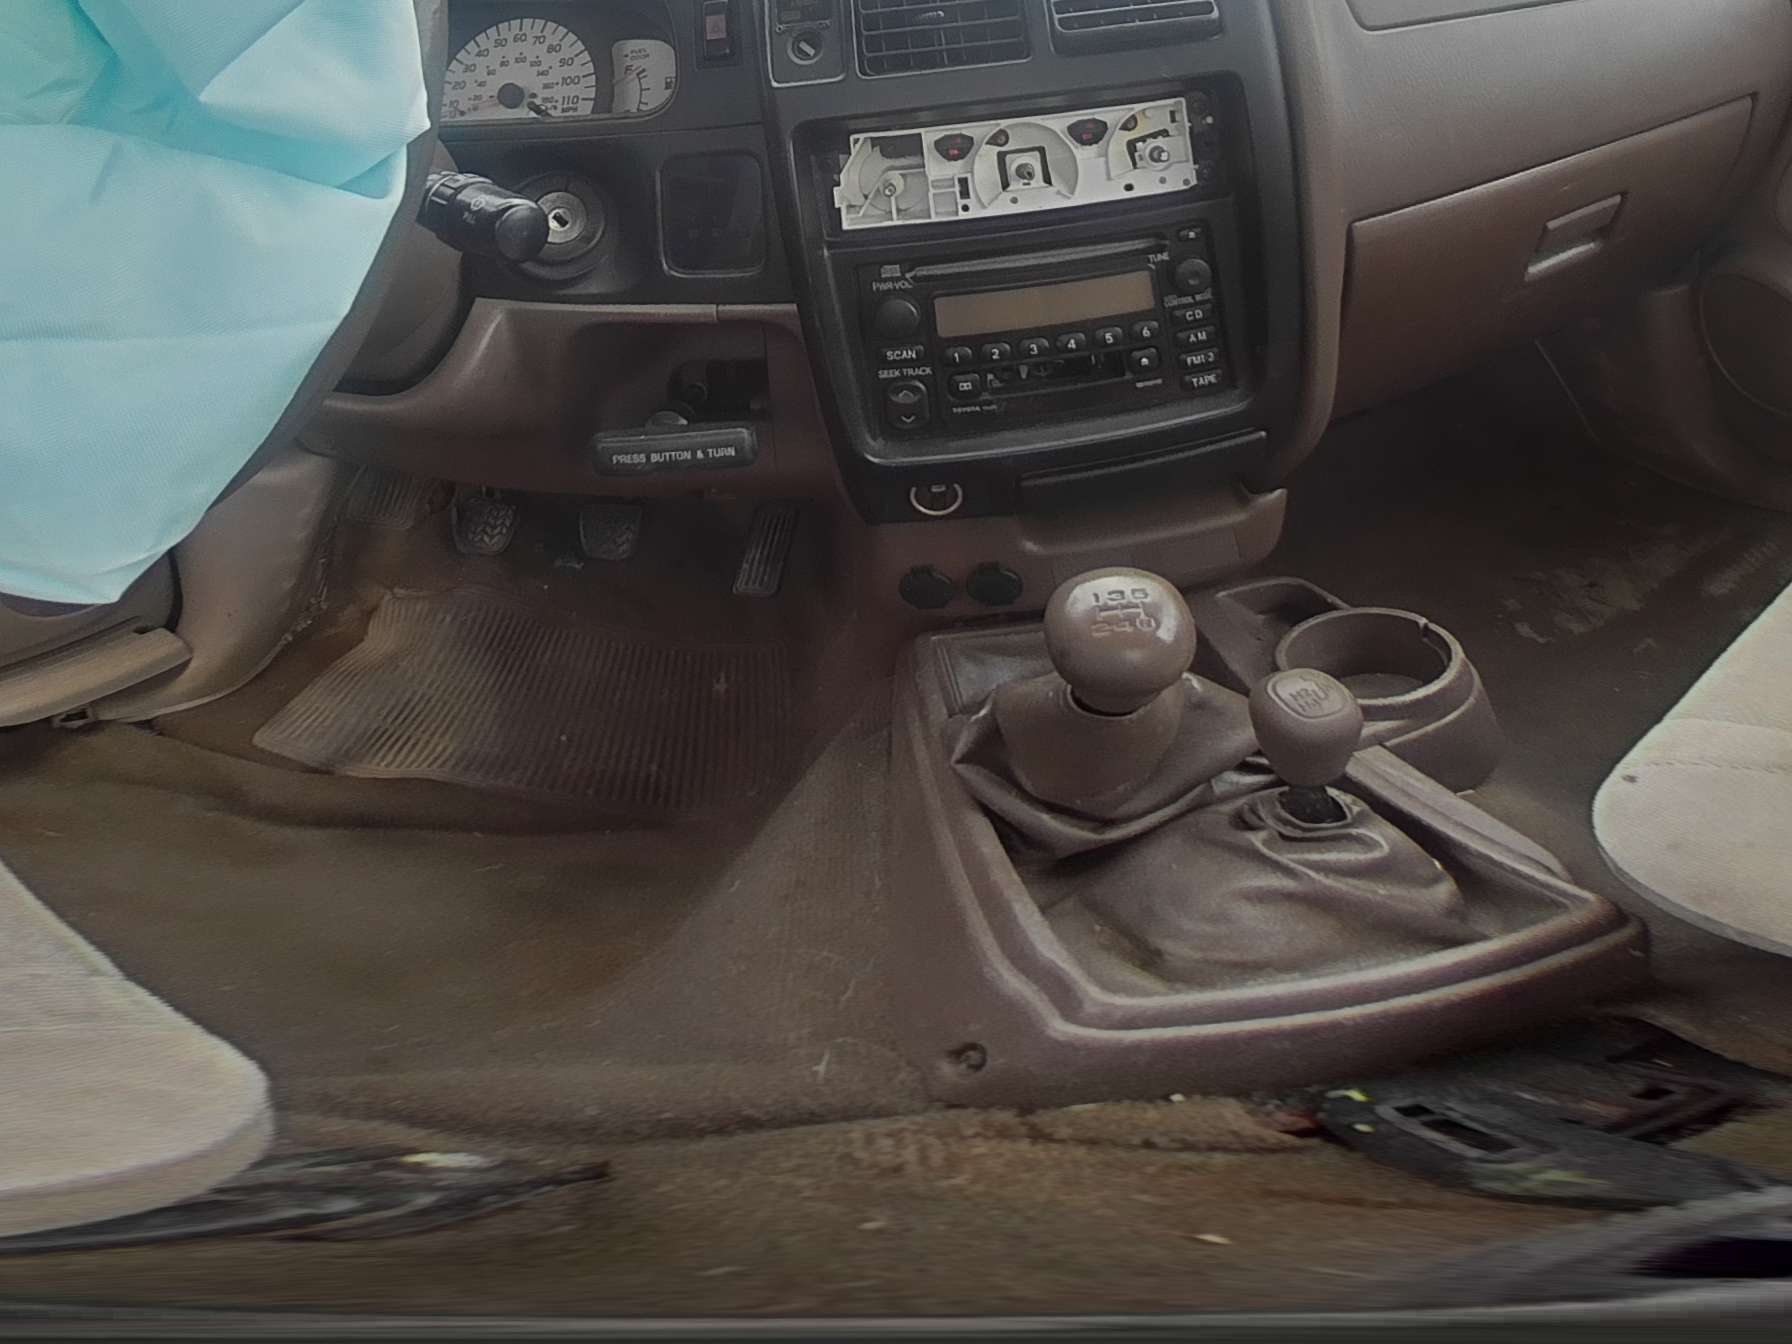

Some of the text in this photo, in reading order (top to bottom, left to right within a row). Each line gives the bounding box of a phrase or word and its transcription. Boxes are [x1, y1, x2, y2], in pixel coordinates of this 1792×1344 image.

[493, 37, 508, 48] 50
[513, 33, 527, 43] 60
[532, 35, 546, 45] 70
[475, 48, 489, 57] 40
[546, 43, 562, 54] 80
[514, 56, 527, 64] 100
[529, 59, 542, 67] 120
[558, 56, 574, 67] 90
[462, 63, 477, 73] 30
[624, 64, 634, 75] F
[451, 80, 467, 90] 20
[560, 75, 581, 86] 100
[561, 95, 579, 106] 110
[1148, 252, 1170, 264] TUNE
[1142, 326, 1151, 337] 6
[1105, 332, 1114, 344] 5
[1029, 344, 1038, 355] 3
[1067, 338, 1076, 350] 4
[886, 350, 917, 360] SCAN
[954, 353, 960, 363] 1
[991, 348, 1000, 359] 2
[878, 366, 933, 379] SEEK TRACK
[1191, 374, 1218, 388] TAPE
[612, 446, 736, 465] PRESS BUTTON & TURN
[1092, 592, 1100, 603] 1
[1107, 590, 1126, 601] 3
